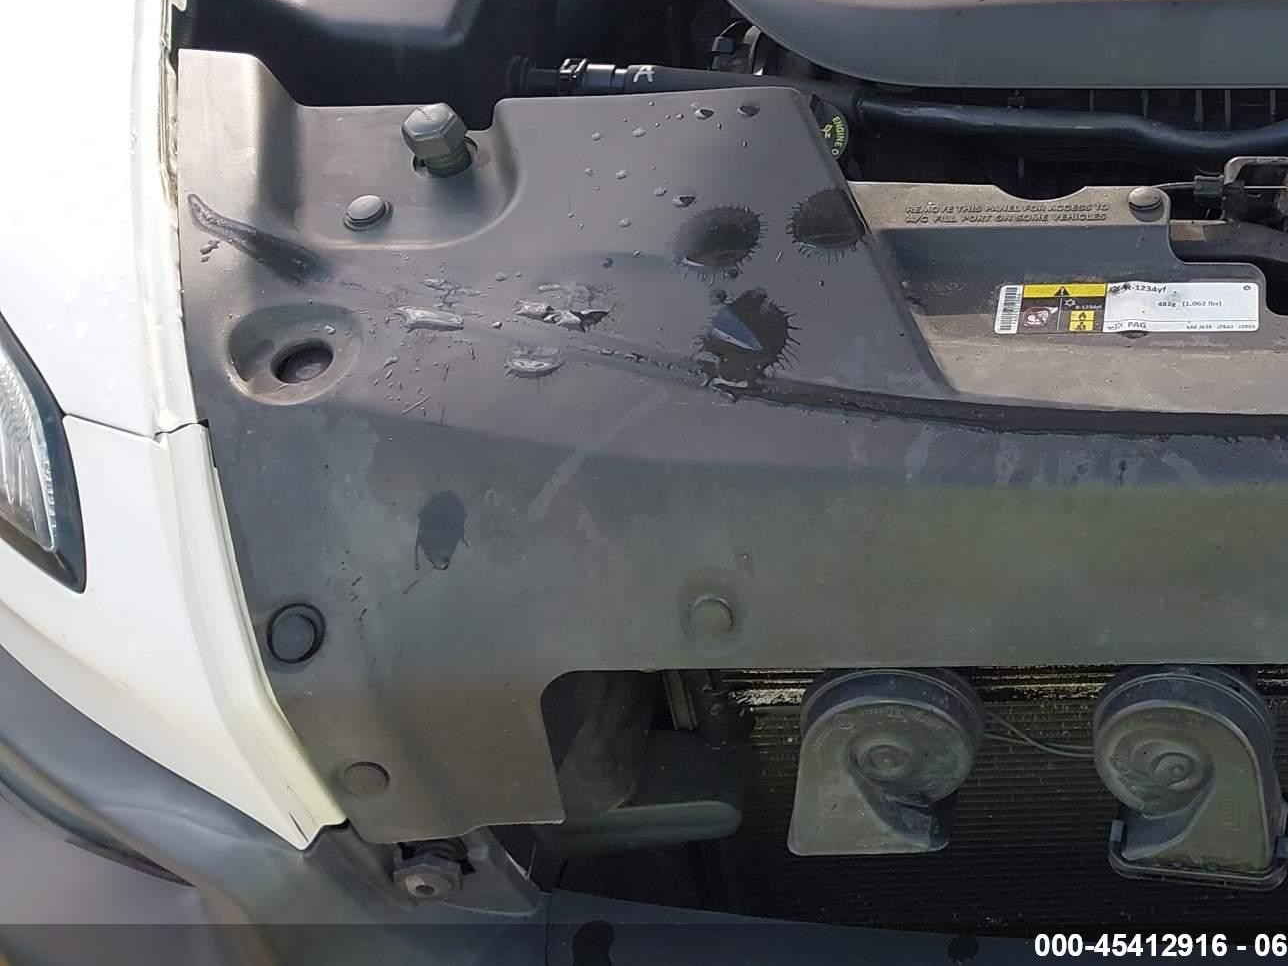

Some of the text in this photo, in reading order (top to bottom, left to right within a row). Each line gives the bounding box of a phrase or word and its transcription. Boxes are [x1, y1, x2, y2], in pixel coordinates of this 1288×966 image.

[832, 116, 845, 148] ENGINE
[906, 203, 1109, 214] REMOVE THIS PANEL FOR ACCESS TO
[906, 212, 1106, 223] A/C FILL PORT ON SOME VEHICLES
[1128, 321, 1147, 329] PAG
